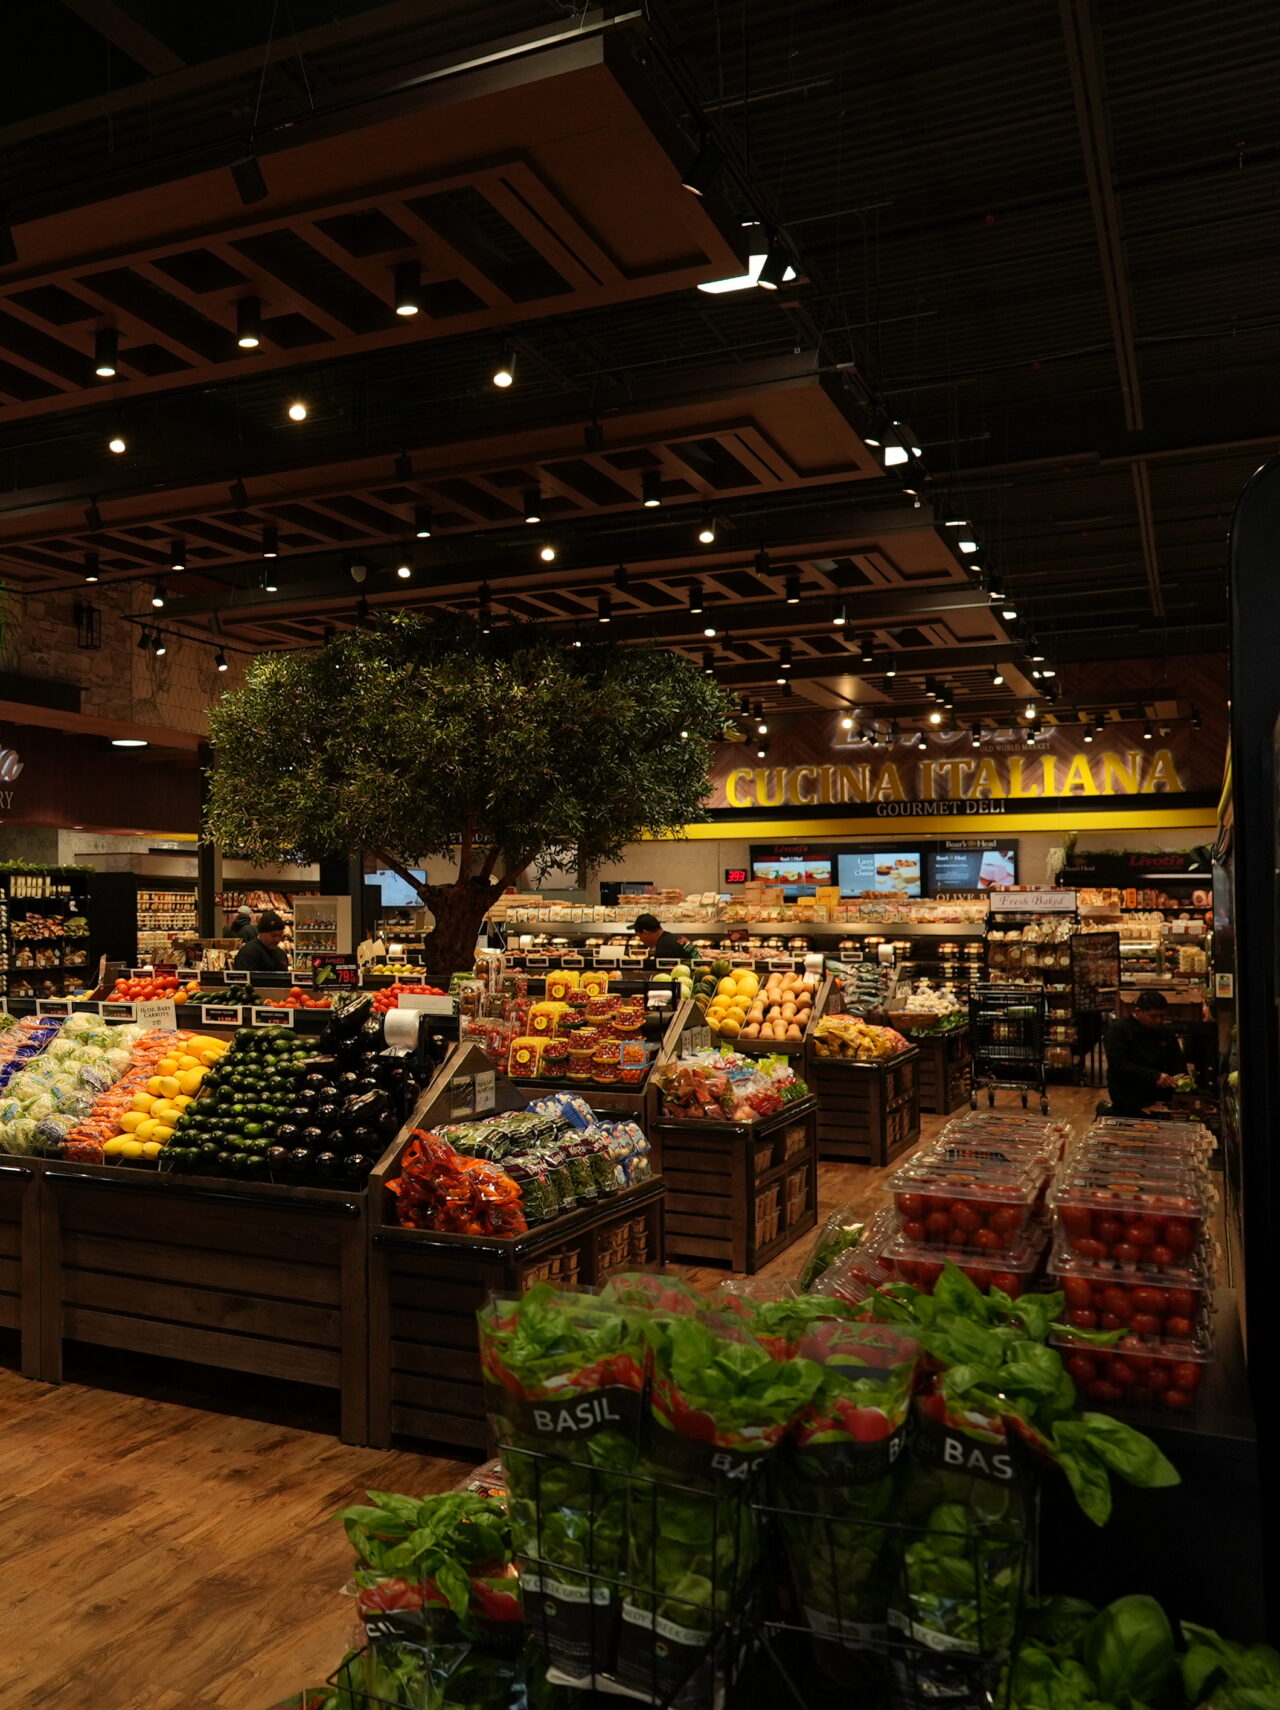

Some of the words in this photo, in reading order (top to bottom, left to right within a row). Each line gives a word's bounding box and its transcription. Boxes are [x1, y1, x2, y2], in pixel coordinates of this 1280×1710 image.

[725, 762, 907, 808] CUCINA
[919, 749, 1186, 801] ITALIANA
[876, 801, 962, 816] GOURMET
[965, 799, 1006, 814] DELI
[727, 870, 746, 882] 393
[1000, 896, 1028, 906] Fresh
[1032, 895, 1066, 906] Baked
[533, 1397, 620, 1433] BASIL
[944, 1436, 1013, 1480] BAS
